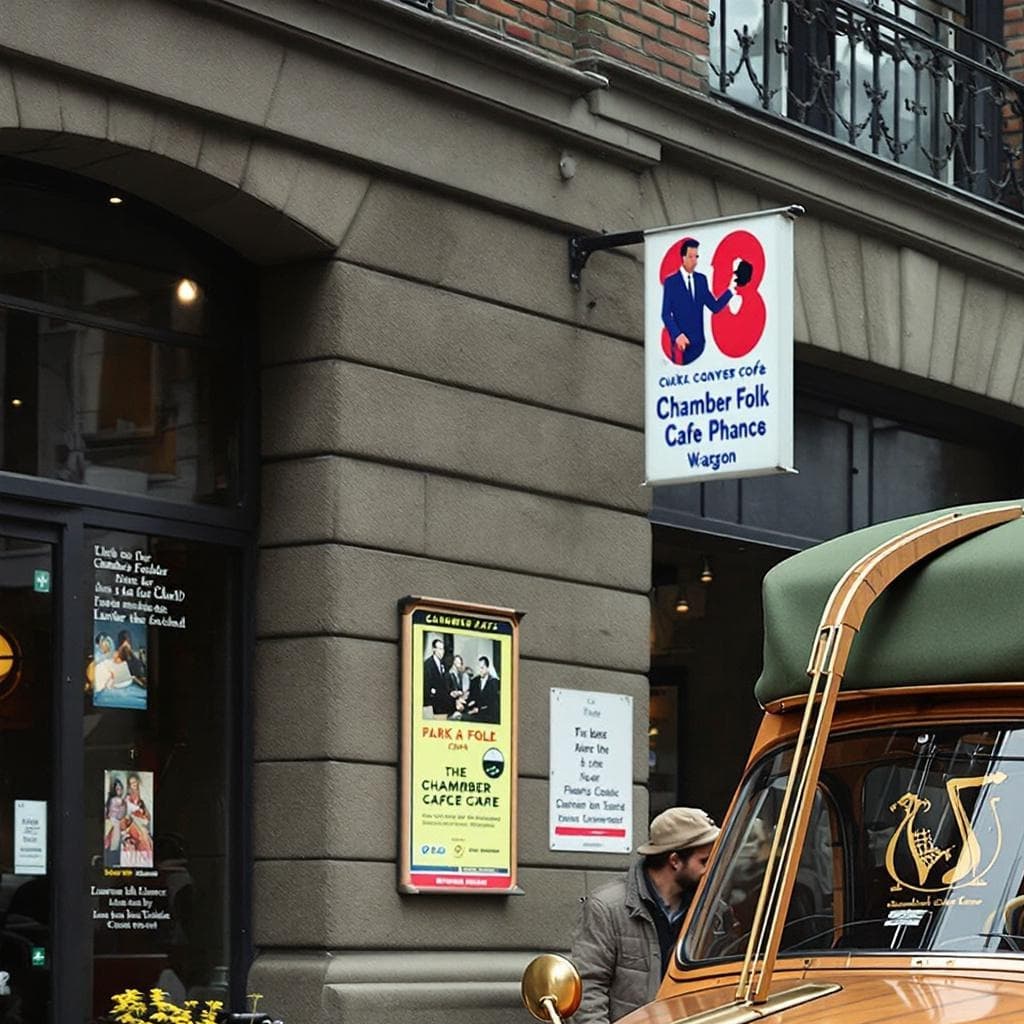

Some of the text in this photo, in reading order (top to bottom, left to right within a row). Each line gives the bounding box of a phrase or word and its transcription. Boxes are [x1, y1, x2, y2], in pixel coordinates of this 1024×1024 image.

[656, 383, 769, 420] Chamber Folk
[665, 422, 702, 447] Cafe
[445, 766, 467, 777] THE
